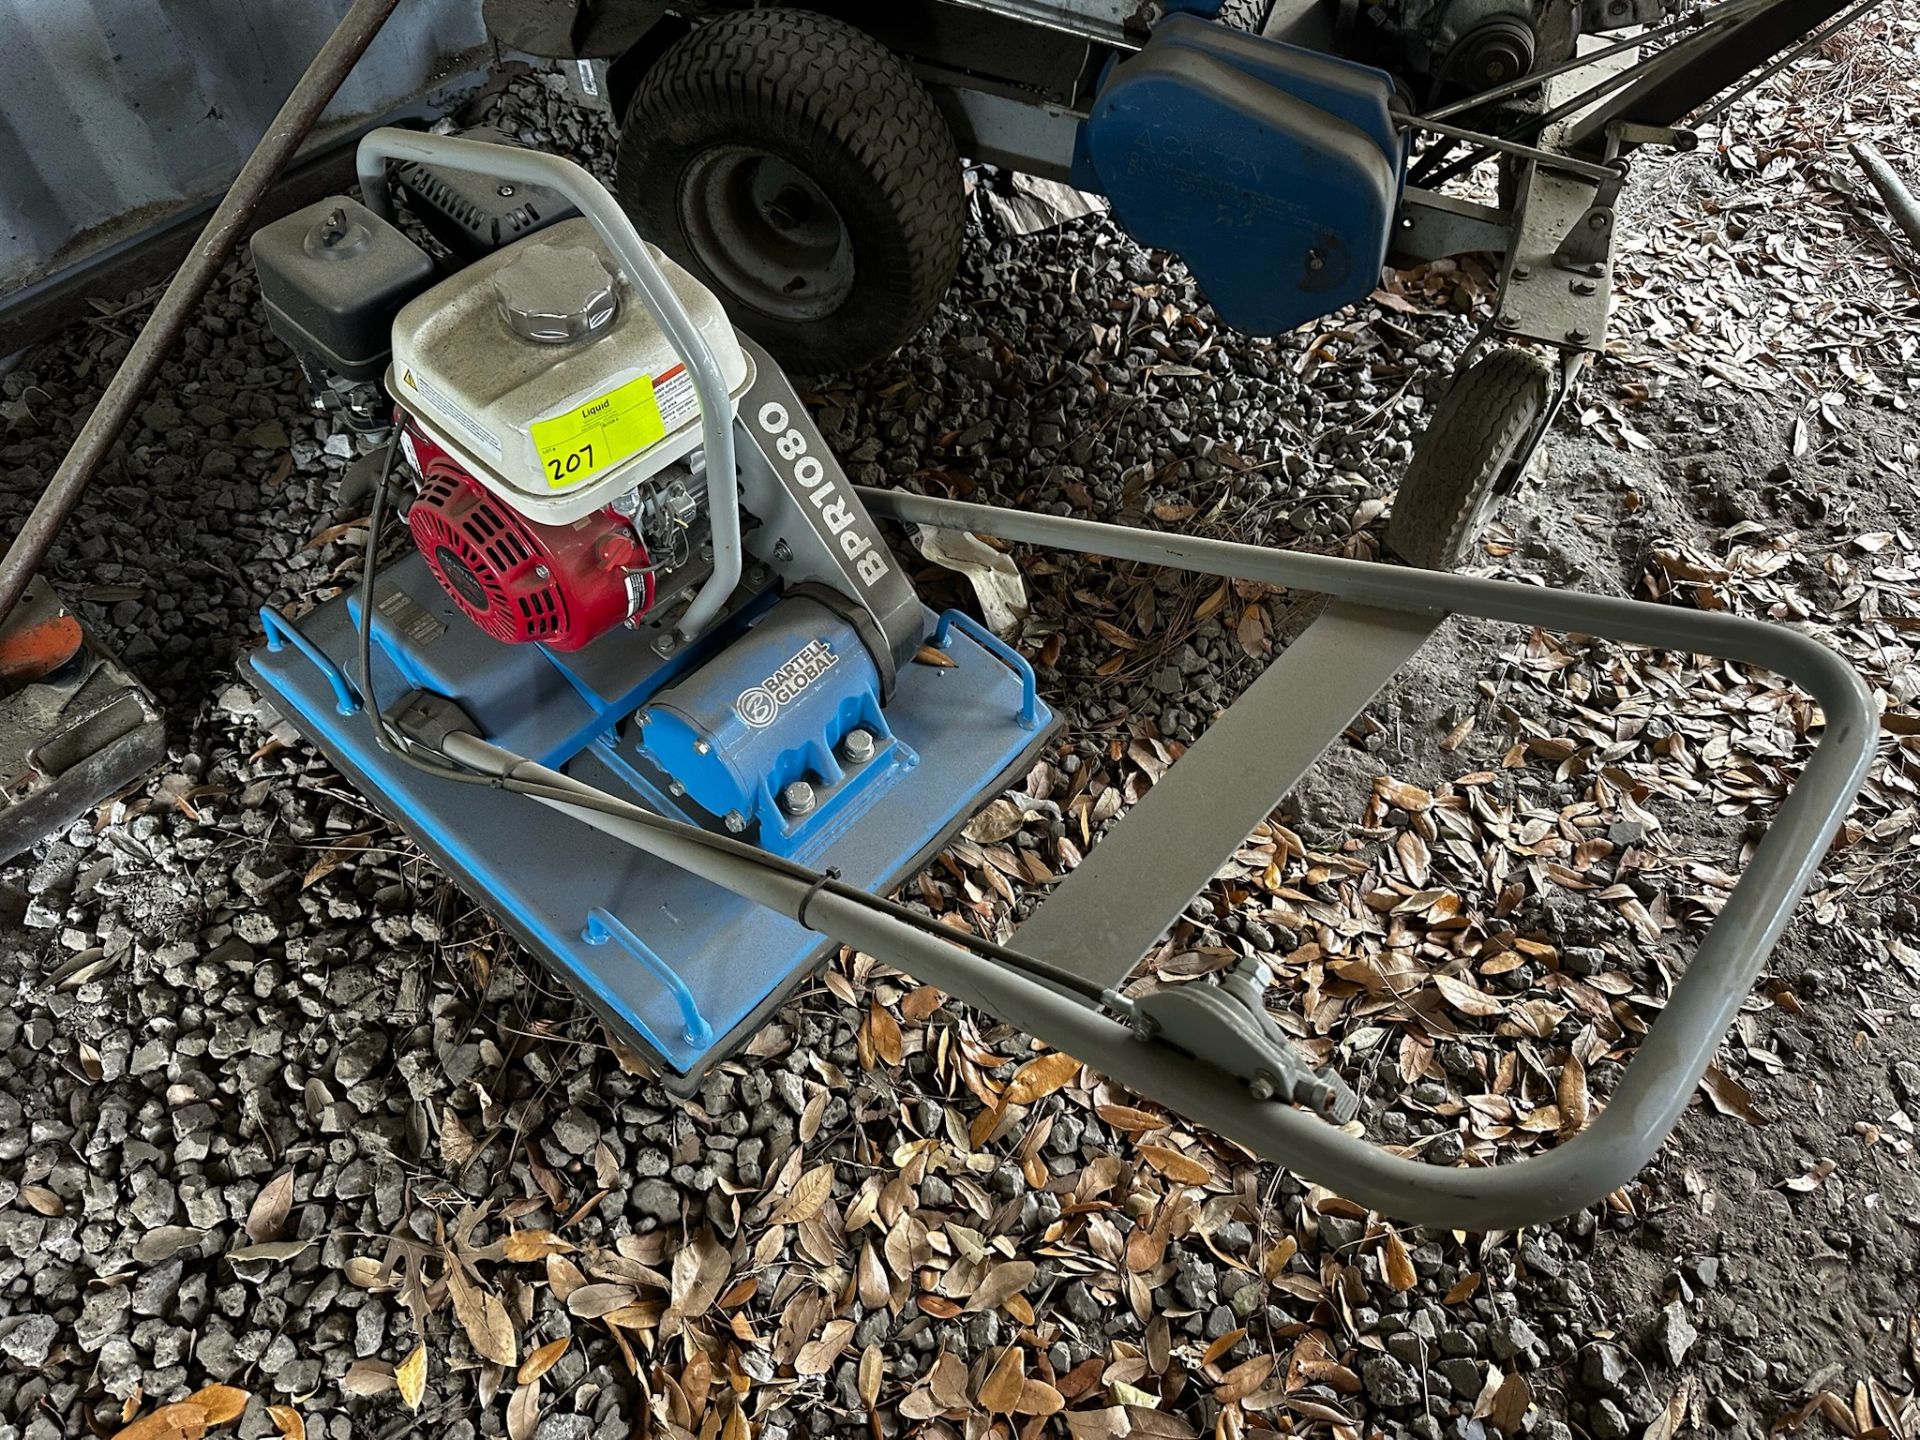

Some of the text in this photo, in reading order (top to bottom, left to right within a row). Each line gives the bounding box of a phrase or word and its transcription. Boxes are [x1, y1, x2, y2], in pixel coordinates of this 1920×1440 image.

[581, 399, 610, 418] Liquid
[548, 443, 594, 480] 207
[758, 401, 890, 587] BPR1080
[763, 641, 828, 694] BARTELL
[775, 652, 838, 703] GLOBAL
